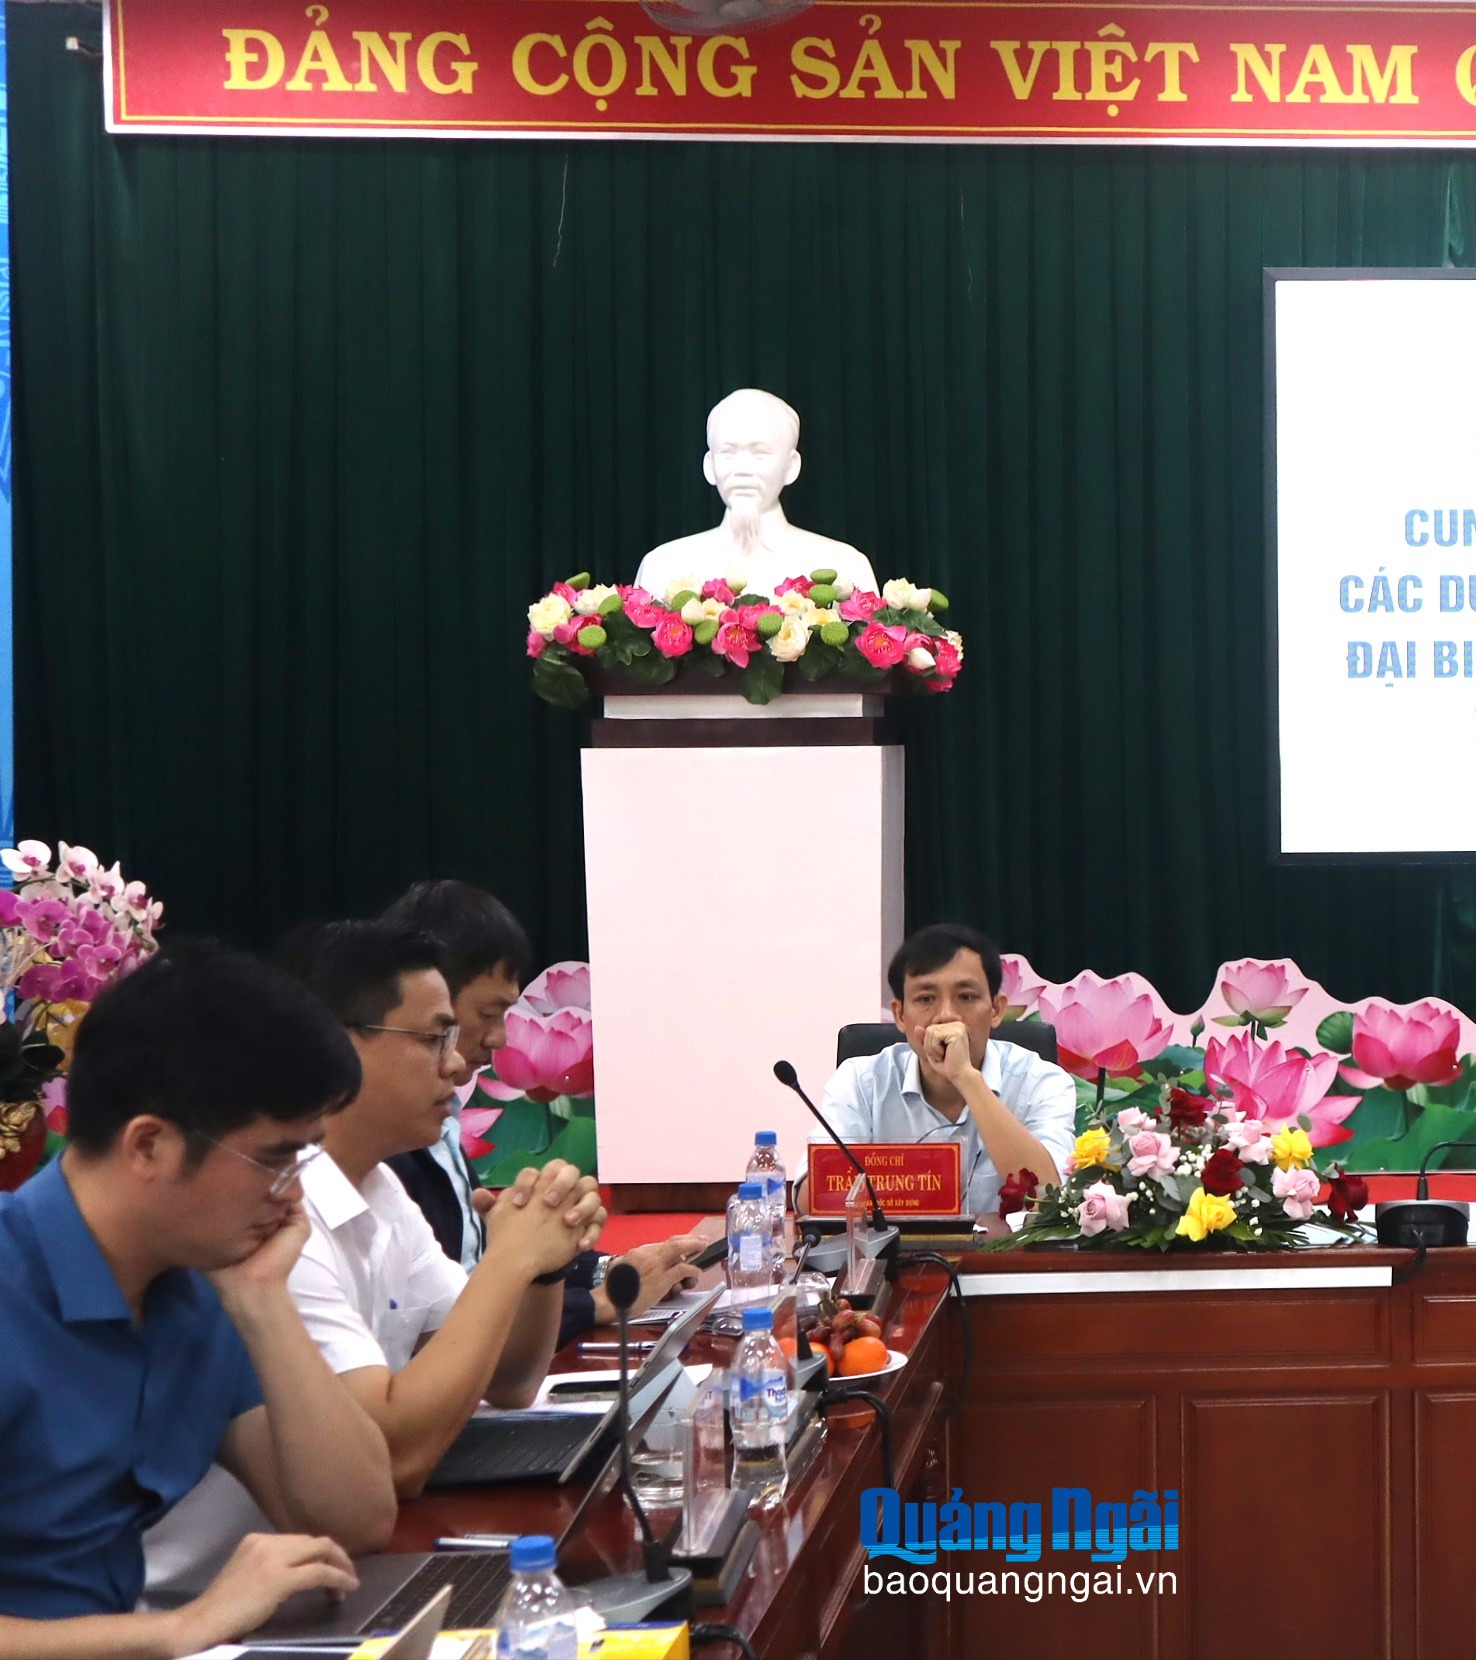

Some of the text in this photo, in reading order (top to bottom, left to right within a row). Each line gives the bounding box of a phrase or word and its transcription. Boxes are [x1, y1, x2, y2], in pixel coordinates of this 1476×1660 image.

[222, 5, 479, 95] ĐẢNG
[511, 15, 757, 111] CỘNG
[788, 12, 962, 99] SẢN
[990, 23, 1201, 117] VIỆT
[1230, 43, 1420, 105] NAM
[1339, 565, 1424, 614] CÁC
[1345, 640, 1417, 688] ĐẠI
[867, 1175, 915, 1191] TRUNG
[917, 1169, 942, 1191] TÍN
